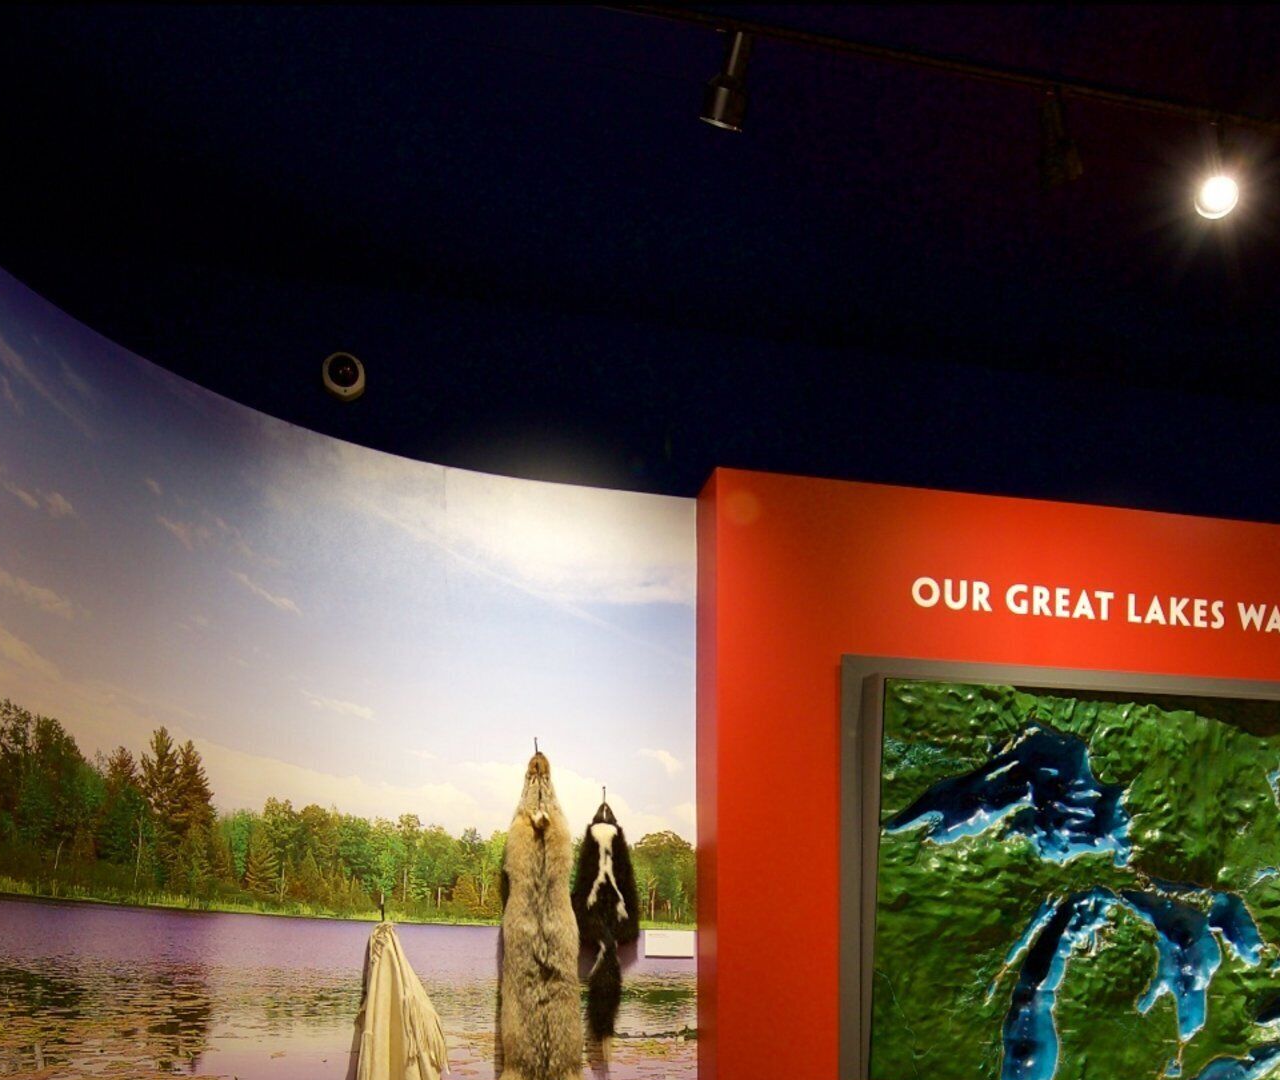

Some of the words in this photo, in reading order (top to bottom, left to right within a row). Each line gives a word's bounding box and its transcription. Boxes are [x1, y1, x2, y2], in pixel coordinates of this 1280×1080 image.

[911, 577, 992, 612] OUR
[1006, 584, 1114, 621] GREAT
[1127, 593, 1225, 629] LAKES
